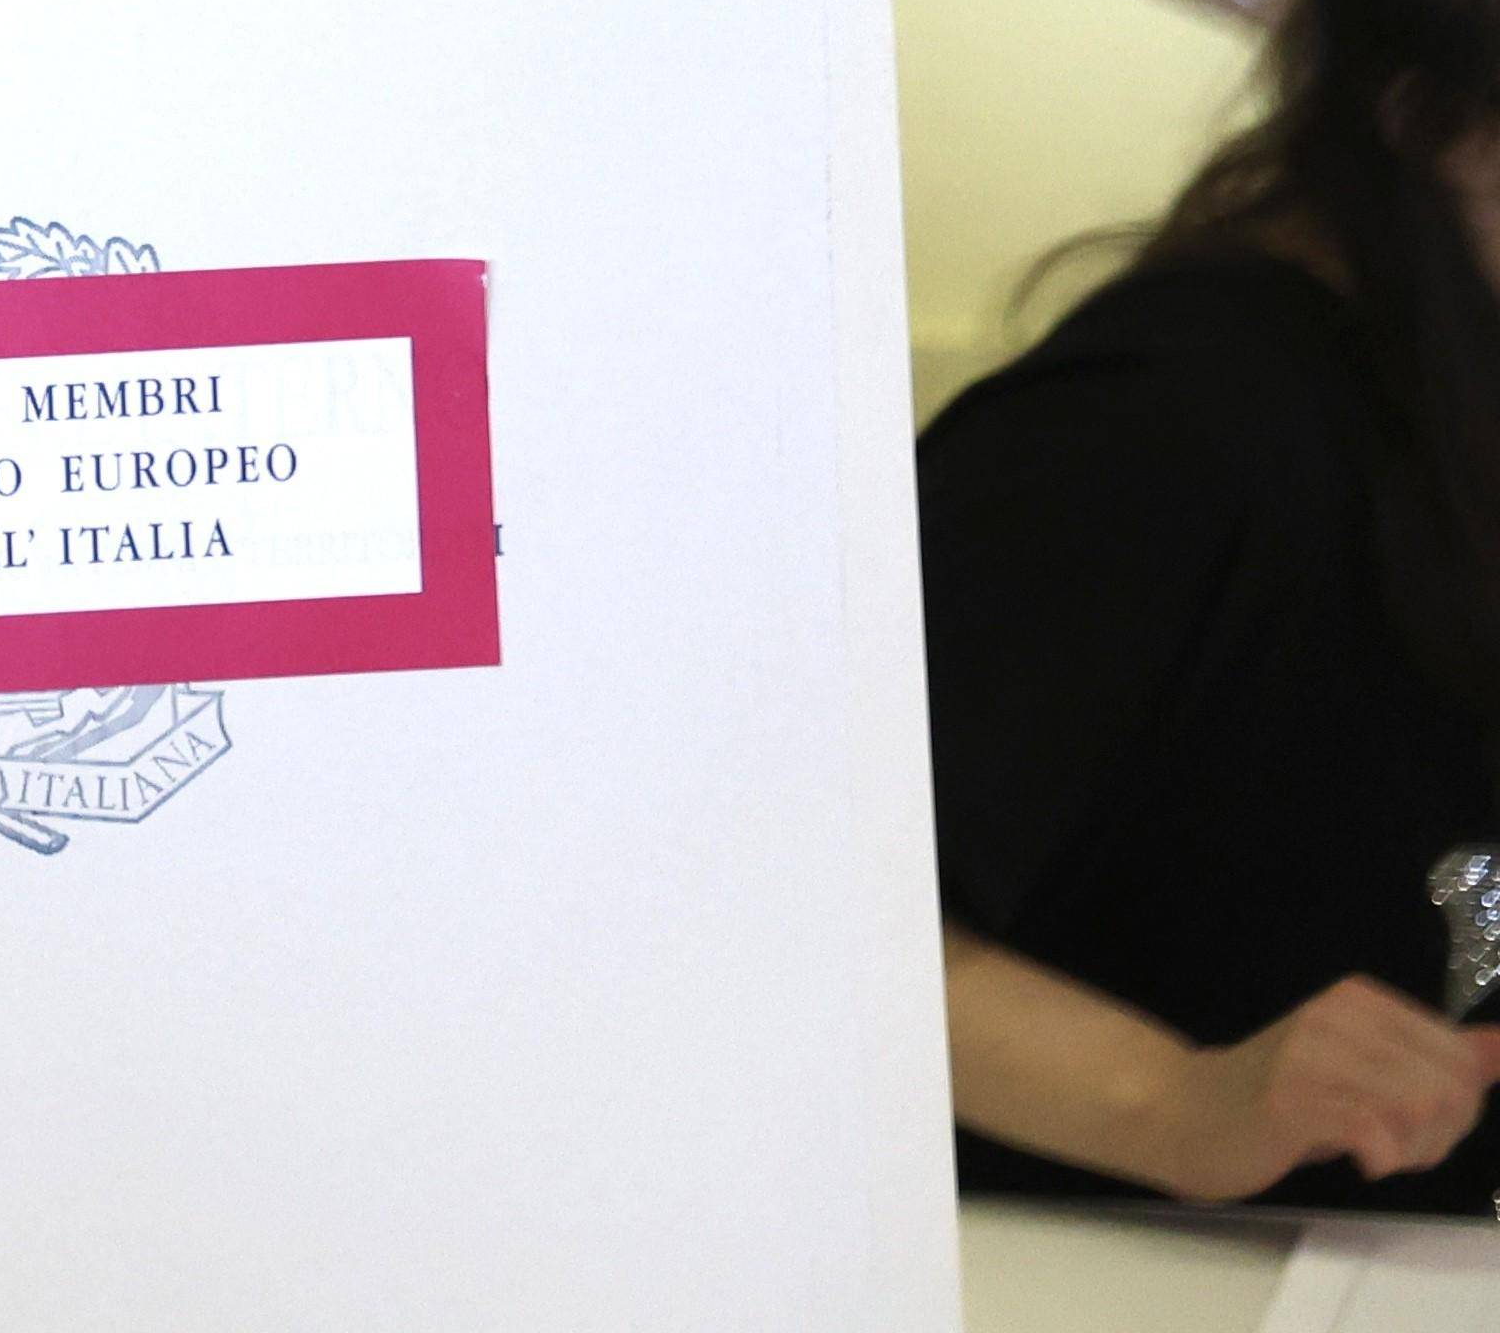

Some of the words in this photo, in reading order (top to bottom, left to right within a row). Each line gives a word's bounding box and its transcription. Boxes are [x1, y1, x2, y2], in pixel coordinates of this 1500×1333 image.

[20, 374, 226, 425] MEMBRI
[60, 442, 300, 496] EUROPEO
[18, 730, 215, 811] ITALIANA
